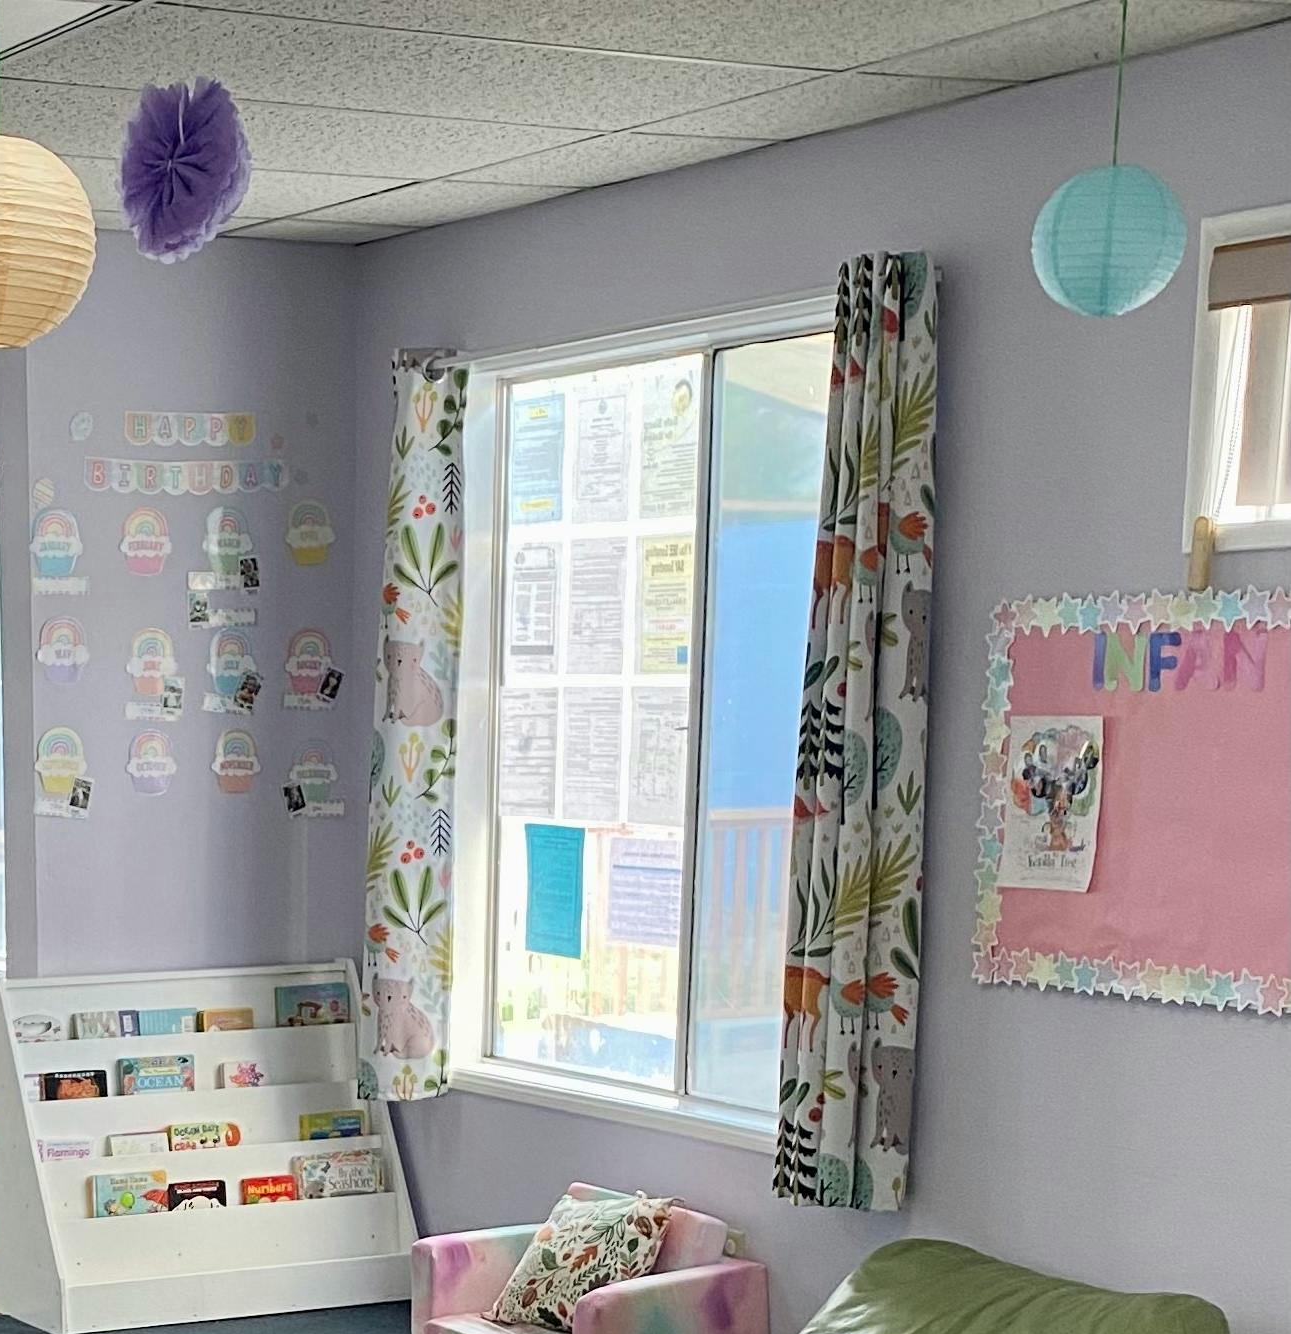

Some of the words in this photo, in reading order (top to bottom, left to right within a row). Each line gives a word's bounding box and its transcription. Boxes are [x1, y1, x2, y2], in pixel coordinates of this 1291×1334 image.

[131, 415, 249, 442] HAPPY
[90, 462, 284, 491] BIRTHDAY
[137, 1075, 183, 1089] OCEAN
[47, 1148, 90, 1159] Flamingo
[351, 1165, 364, 1176] the
[248, 1183, 293, 1194] Numbers
[328, 1176, 373, 1190] Seashore
